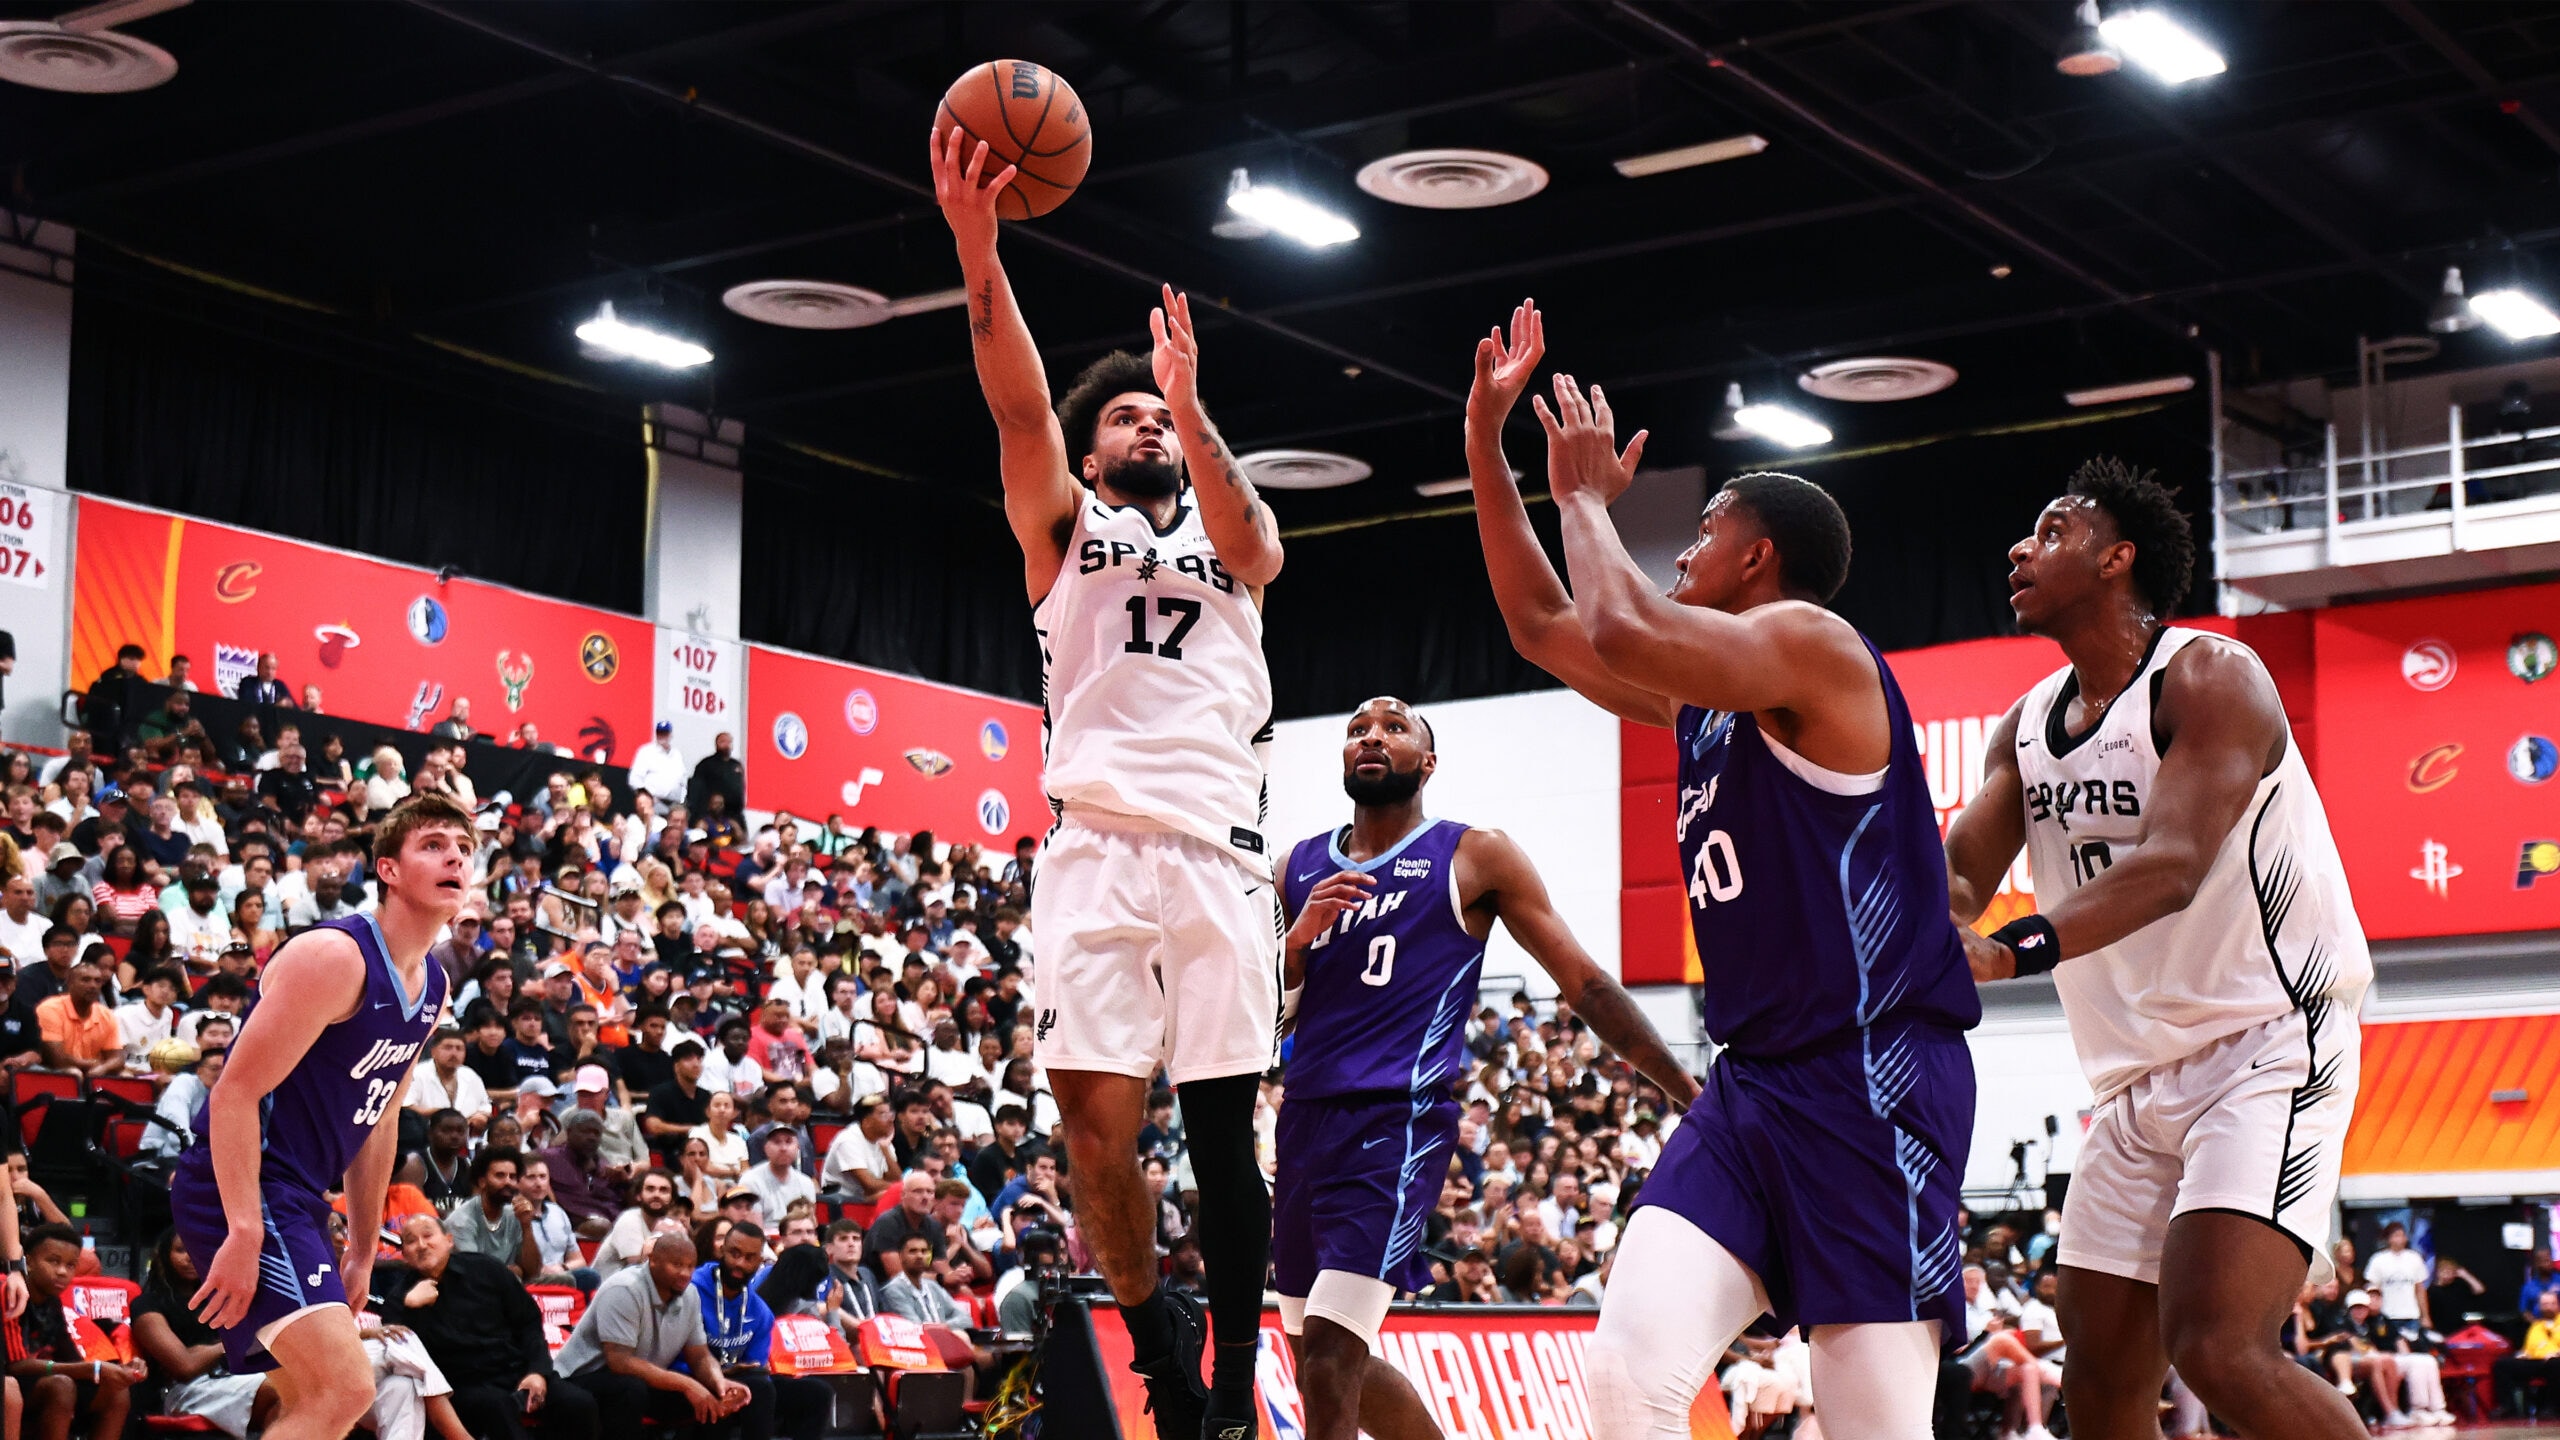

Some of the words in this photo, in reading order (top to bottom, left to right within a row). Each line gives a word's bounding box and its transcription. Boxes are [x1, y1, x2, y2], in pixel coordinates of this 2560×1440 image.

[0, 496, 34, 531] 06
[0, 546, 31, 577] 07
[1124, 595, 1202, 661] 17
[684, 644, 718, 673] 107
[683, 685, 716, 714] 108
[1393, 866, 1430, 879] Equity
[1395, 857, 1432, 869] Health
[1689, 830, 1744, 910] 40
[1361, 935, 1396, 986] 0
[350, 1038, 420, 1080] UTAH
[353, 1078, 398, 1126] 33
